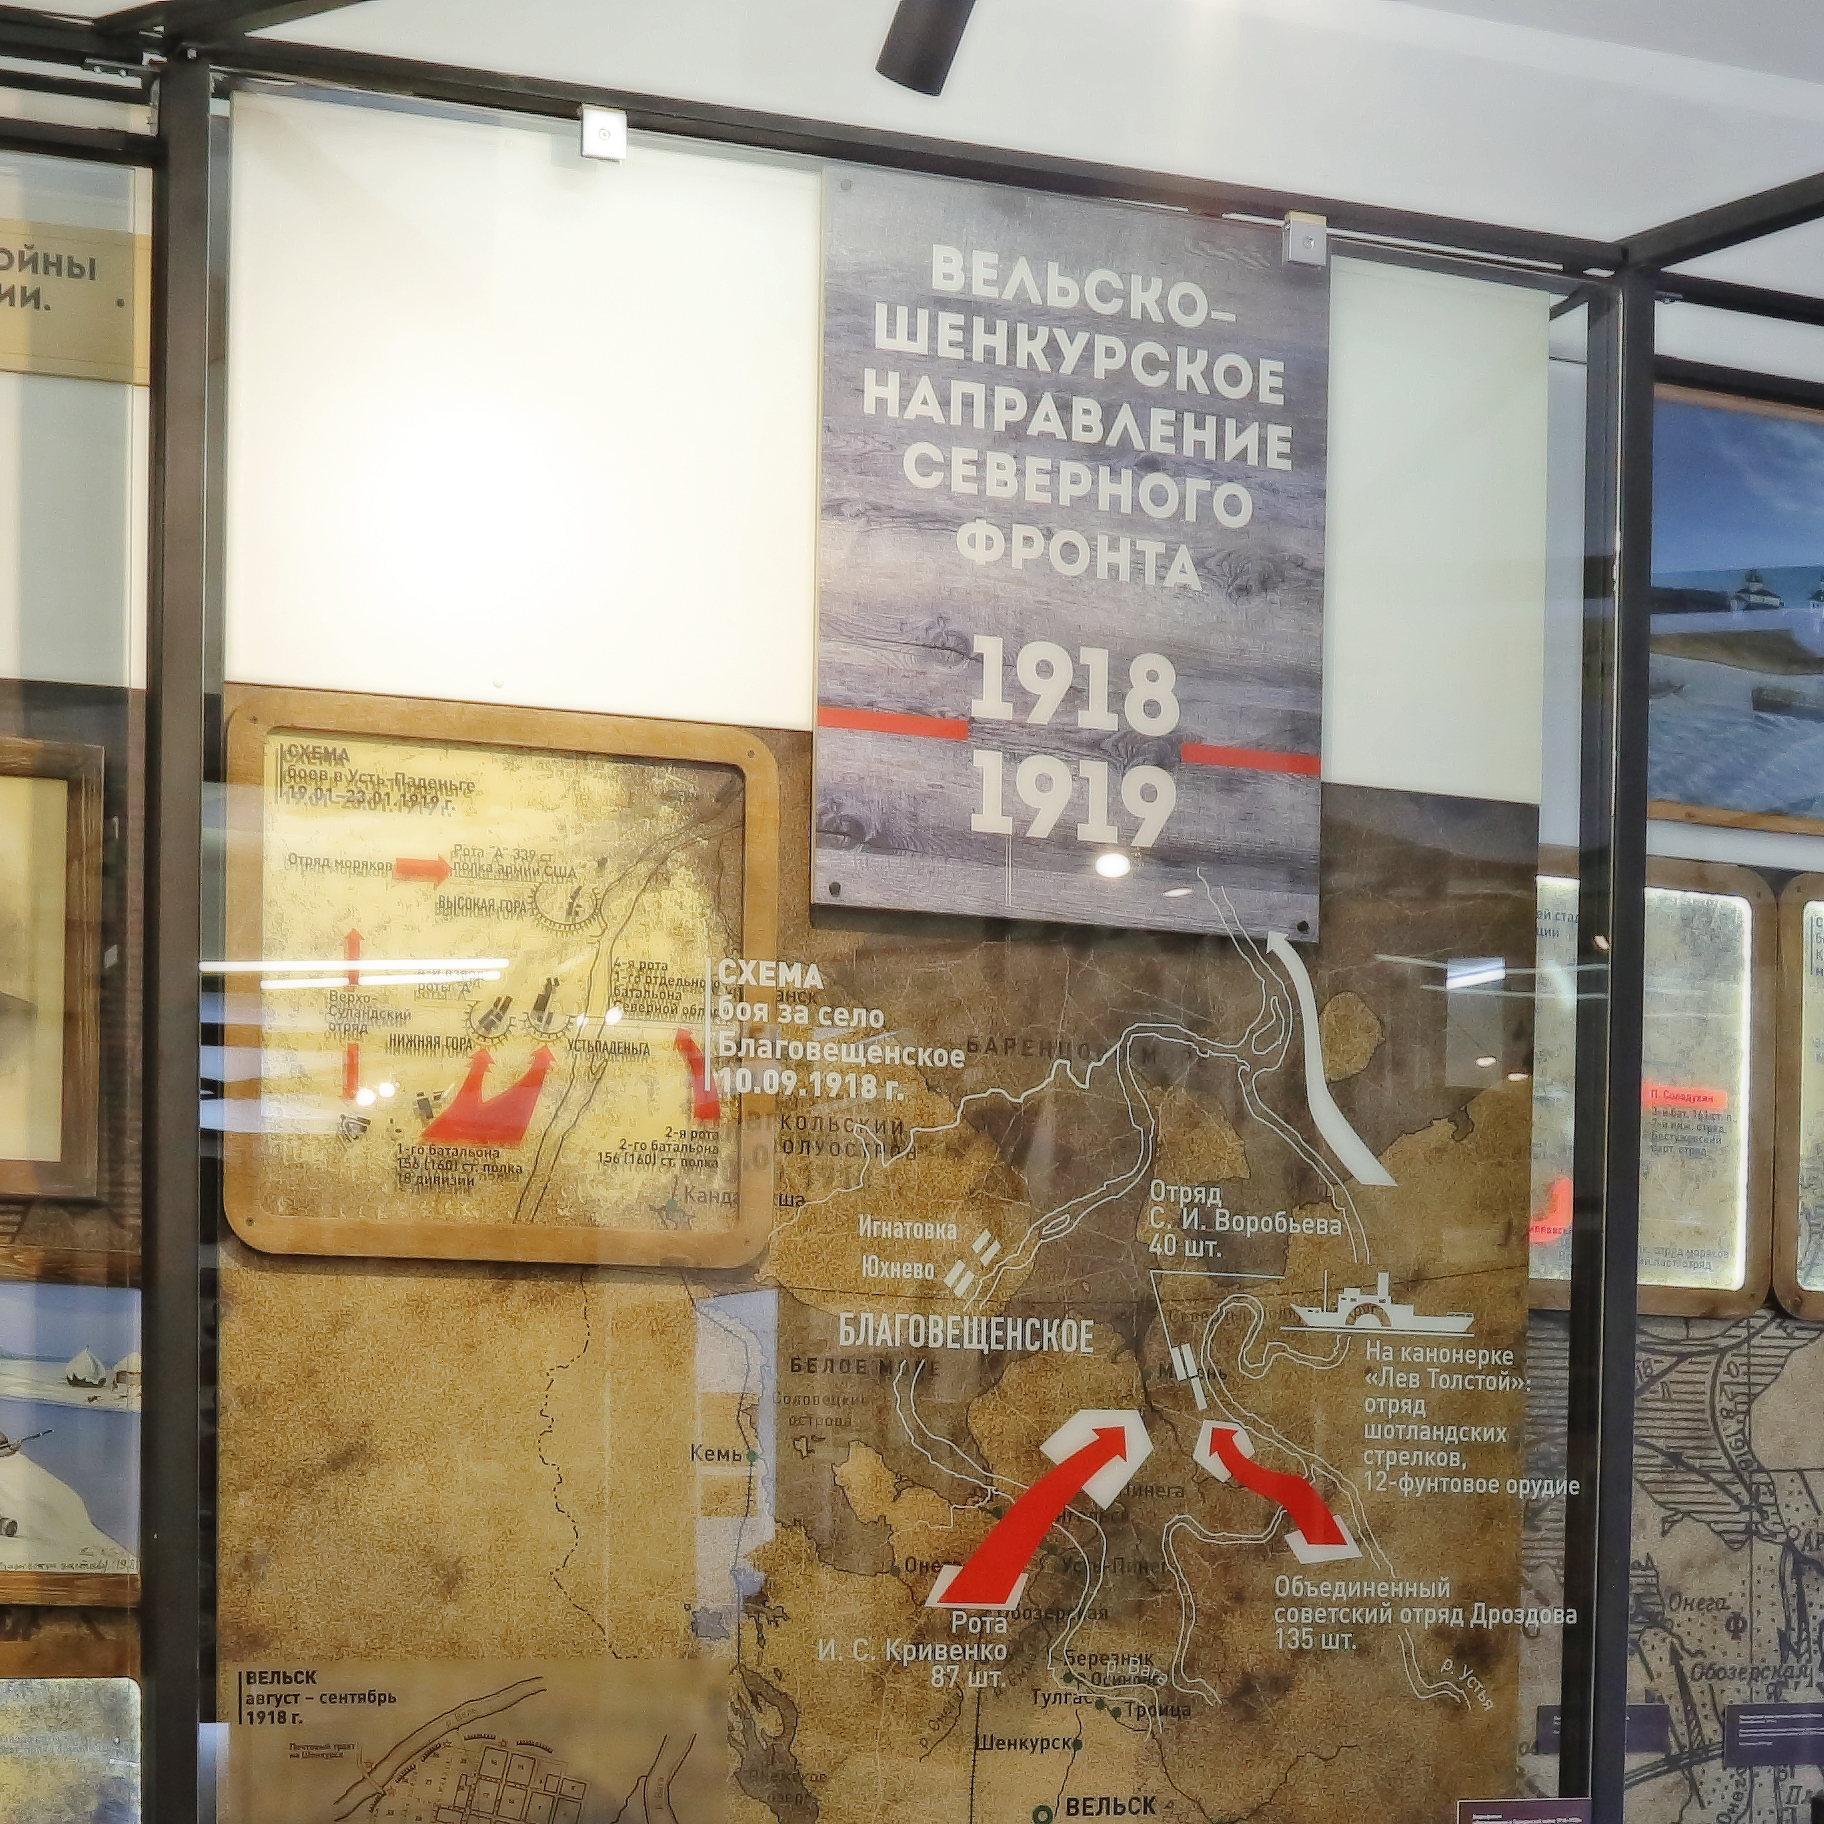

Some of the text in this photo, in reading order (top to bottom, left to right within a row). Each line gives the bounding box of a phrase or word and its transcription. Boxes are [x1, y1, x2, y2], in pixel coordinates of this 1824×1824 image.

[875, 301, 1285, 406] ШЕНКУРСКОЕ
[863, 367, 1293, 471] НАПРАВЛЕНИЕ
[903, 443, 1253, 529] СЕВЕРНОГО
[956, 518, 1203, 591] ФРОНТА
[971, 635, 1181, 737] 1918
[288, 744, 350, 763] СХЕМА
[288, 765, 475, 793] боев в Усть-Паденьге
[971, 750, 1178, 848] 1919
[289, 853, 392, 873] Отряд моряков
[438, 895, 527, 913] ВЫСОКАЯ ГОРА
[718, 958, 824, 989] СХЕМА
[718, 994, 884, 1028] боя за село
[389, 1034, 473, 1050] НИЖНЯЯ ГОРА
[719, 1031, 966, 1067] Благовещенское
[719, 1067, 904, 1101] 10.09.1918 г.
[652, 1140, 719, 1154] батальона
[1150, 1180, 1222, 1208] Отряд
[858, 1214, 957, 1240] Игнатовка
[1150, 1206, 1342, 1238] С. И. Воробьева
[1149, 1234, 1222, 1259] 40 шт.
[862, 1254, 935, 1281] Юхнево
[839, 1312, 1094, 1354] БЛАГОВЕЩЕНСКОЕ
[1366, 1340, 1514, 1369] На канонерке
[1365, 1366, 1532, 1392] «Лев Толстой»:
[1365, 1396, 1426, 1417] отряд
[1364, 1423, 1507, 1444] шотландских
[1364, 1450, 1467, 1469] стрелков,
[1365, 1471, 1580, 1498] 12-фунтовое орудие
[1275, 1575, 1451, 1599] Объединенный
[1670, 1592, 1731, 1612] Онега
[952, 1611, 1008, 1635] Рота
[1275, 1602, 1577, 1629] советский отряд Дроздова
[1275, 1628, 1357, 1650] 135 шт.
[818, 1639, 1008, 1666] И. С. Кривенко
[246, 1670, 317, 1684] ВЕЛЬСК
[930, 1665, 1005, 1689] 87 шт.
[246, 1689, 397, 1708] август сентябрь
[246, 1711, 303, 1724] 1918 г.
[976, 1734, 1072, 1754] Шенкурск
[1065, 1796, 1156, 1817] ВЕЛЬСК
